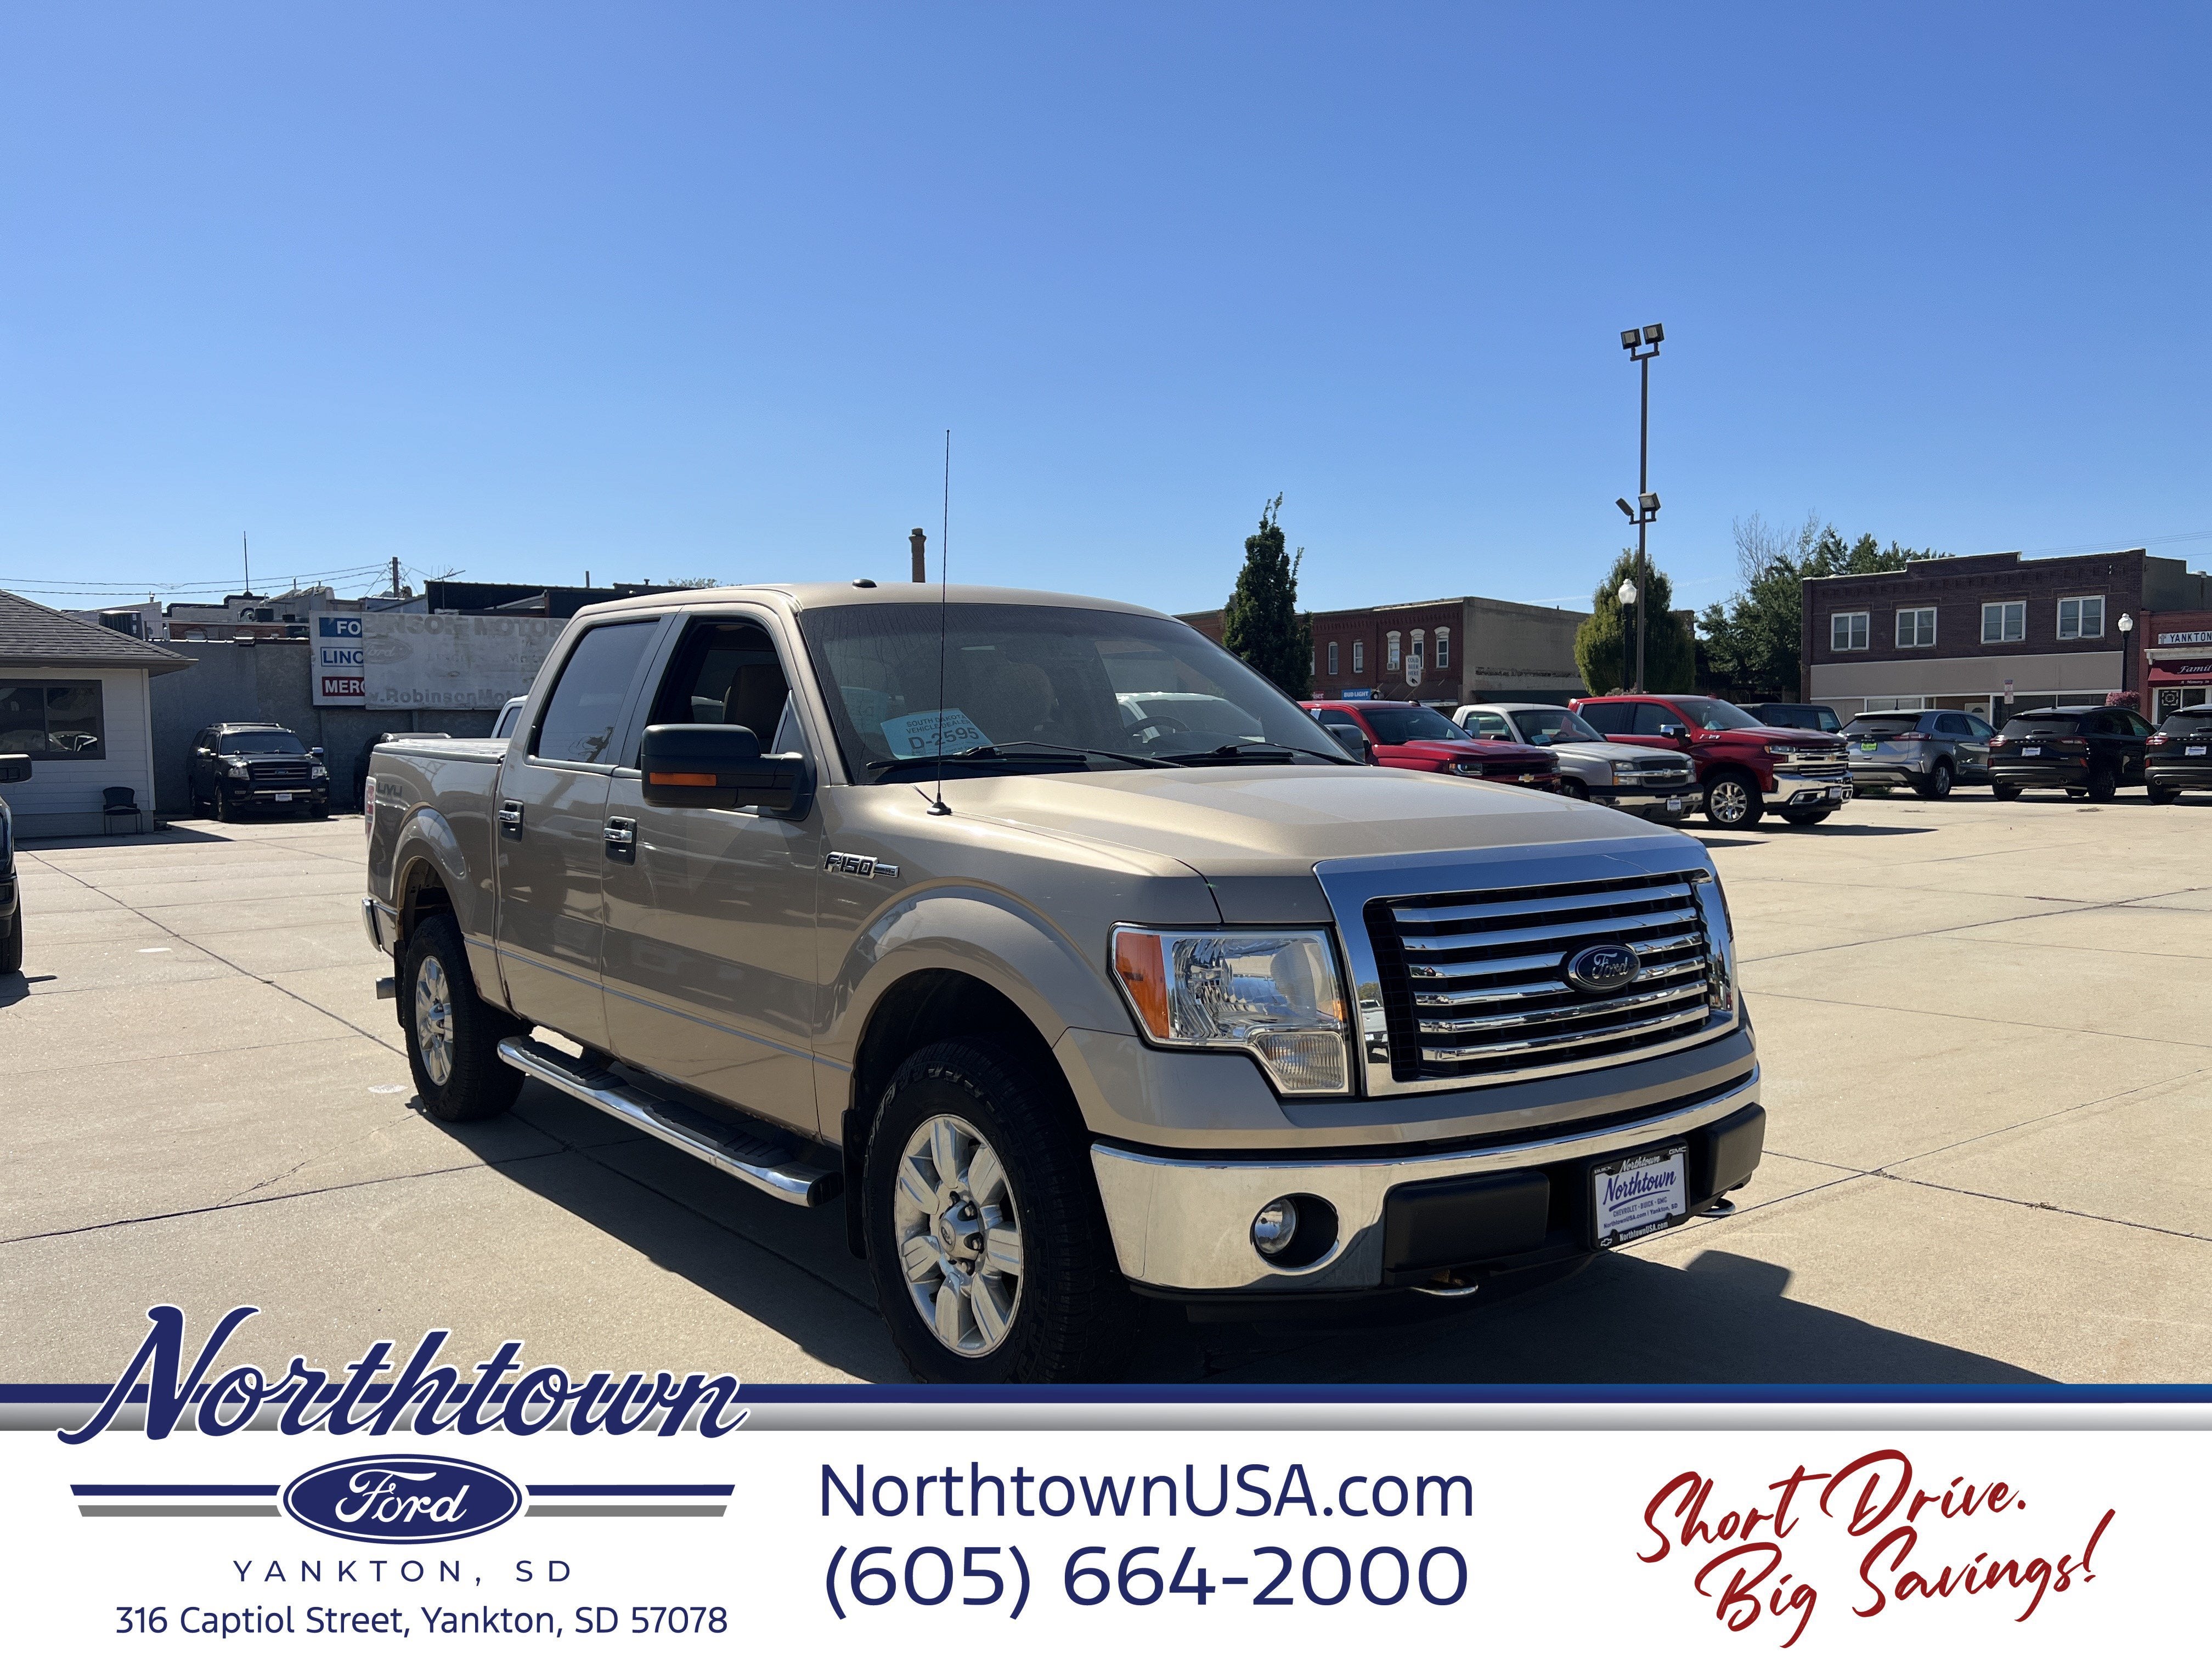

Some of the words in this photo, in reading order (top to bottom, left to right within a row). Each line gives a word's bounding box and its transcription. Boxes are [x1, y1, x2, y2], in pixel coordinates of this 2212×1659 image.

[2170, 632, 2212, 643] YANKTON
[906, 718, 933, 727] SOUTH
[935, 714, 967, 724] DAKOTA
[906, 724, 939, 734] VEHICLE
[941, 720, 972, 729] DEALER
[908, 727, 980, 749] D-2595
[1592, 952, 1629, 979] Ford
[1668, 1146, 1687, 1155] GMC
[1594, 1165, 1612, 1174] BUICK
[1618, 1155, 1661, 1173] Northtown
[1602, 1171, 1677, 1205] Northtown
[1613, 1204, 1637, 1217] CHEVROLET
[1640, 1200, 1654, 1209] BUICK
[1657, 1197, 1668, 1205] GMC
[1604, 1212, 1647, 1229] NorthtownUSA.com
[1620, 1221, 1668, 1242] NorthtownUSA.com
